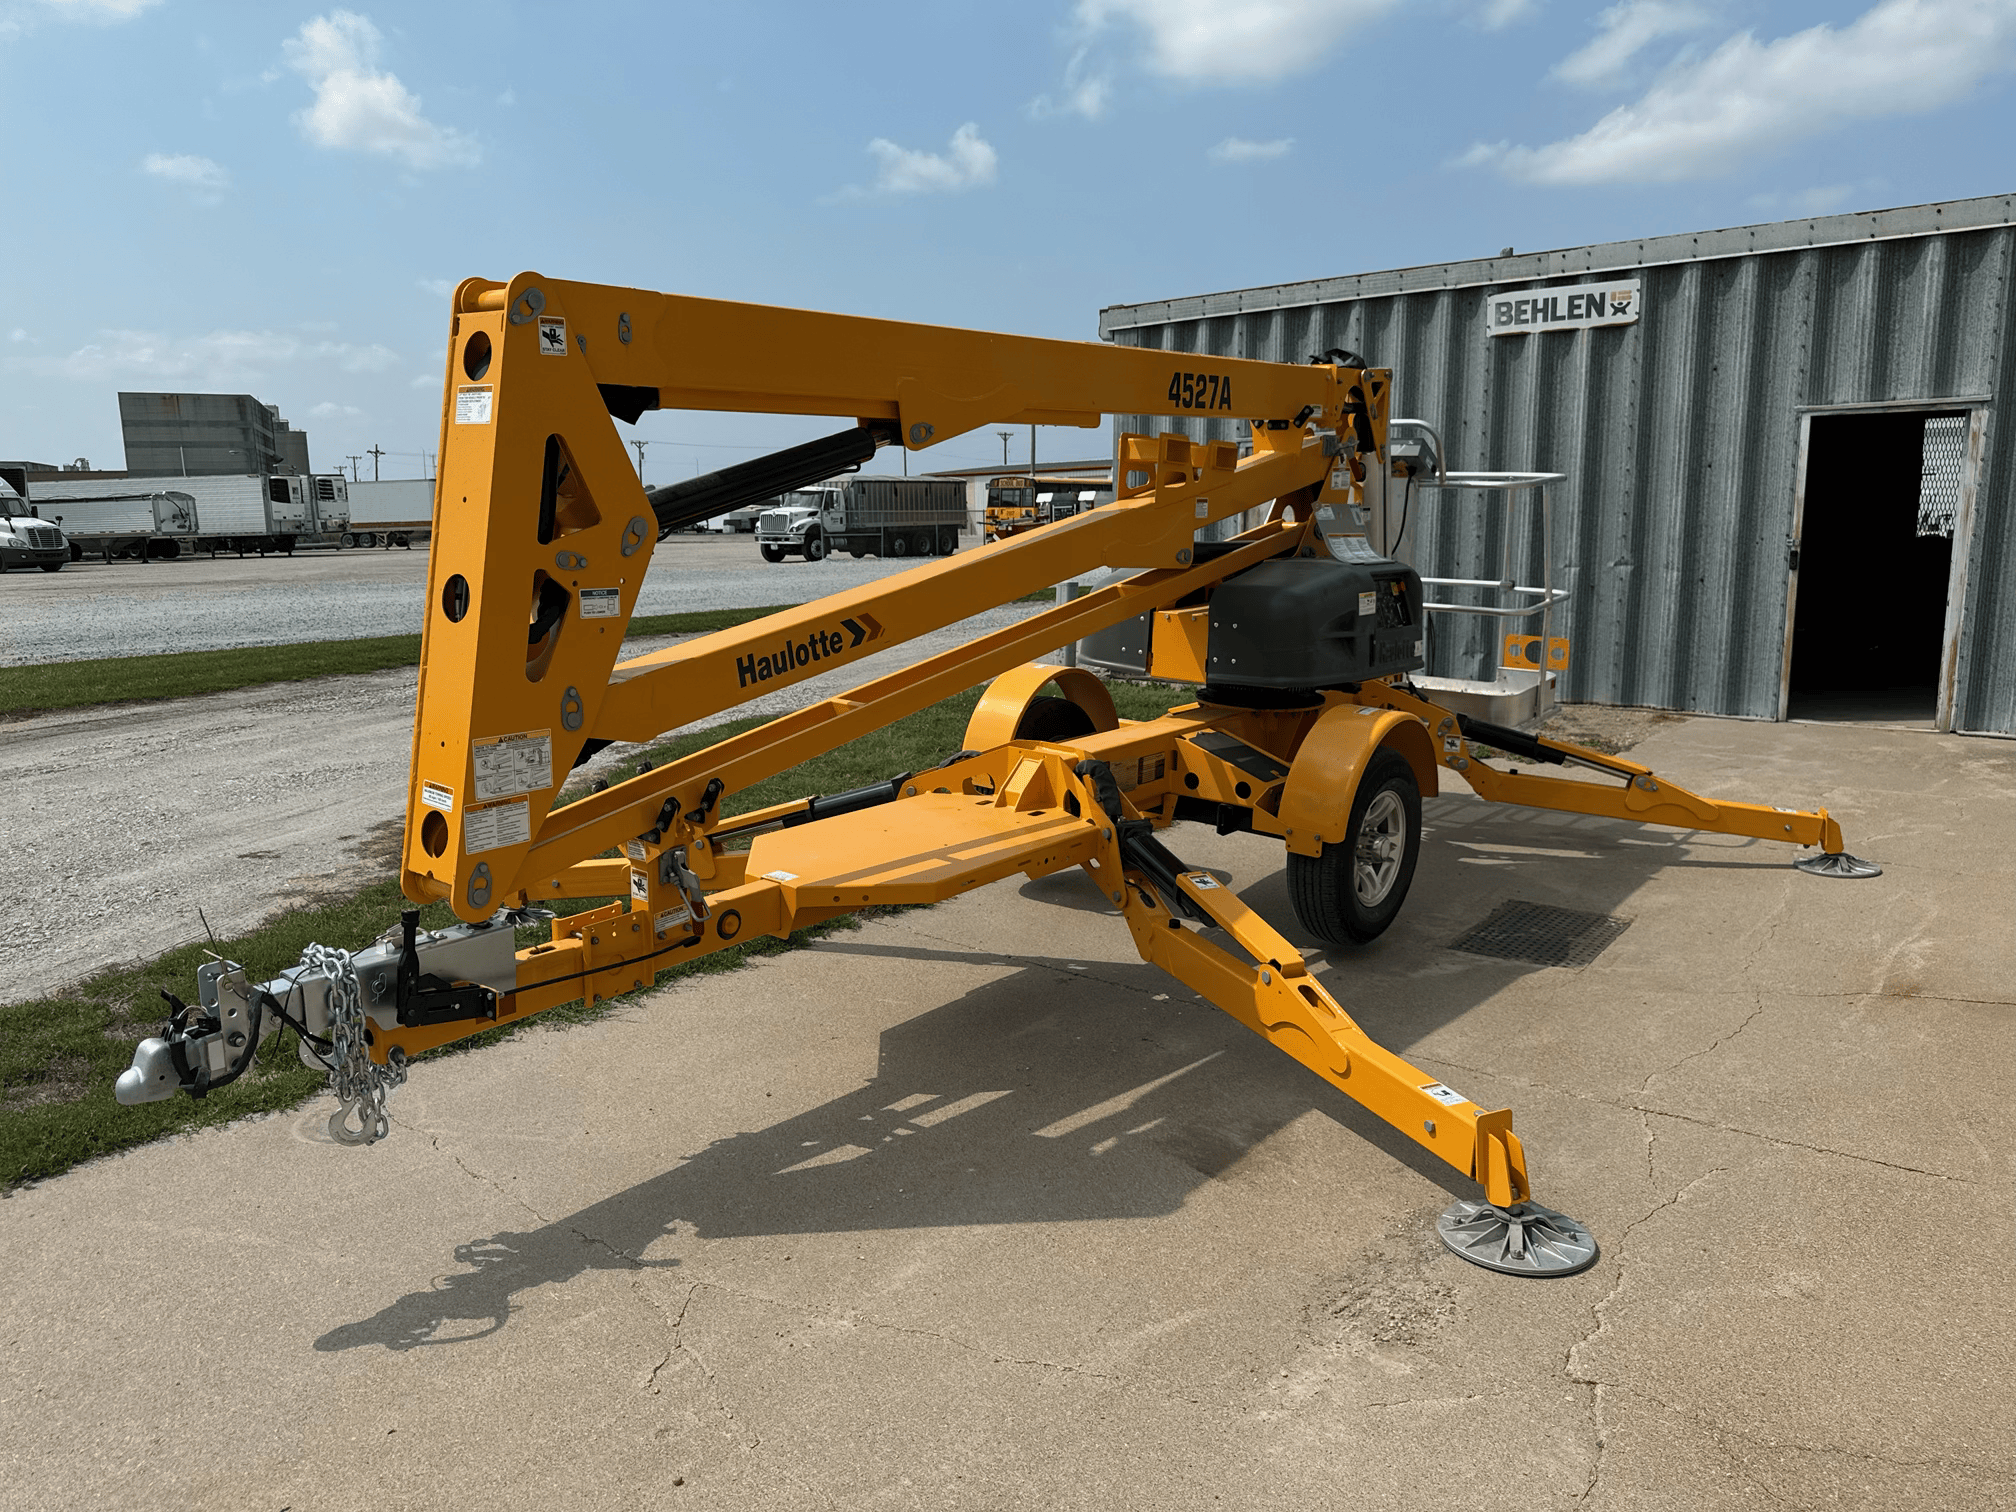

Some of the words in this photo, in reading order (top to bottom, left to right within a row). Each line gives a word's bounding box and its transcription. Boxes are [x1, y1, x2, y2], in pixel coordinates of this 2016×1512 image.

[1494, 292, 1606, 327] BEHLEN
[1168, 372, 1232, 410] 4527A
[736, 630, 843, 688] Haulotte
[503, 733, 528, 742] CAUTION
[487, 798, 511, 808] WARNING
[663, 906, 684, 917] CAUTION
